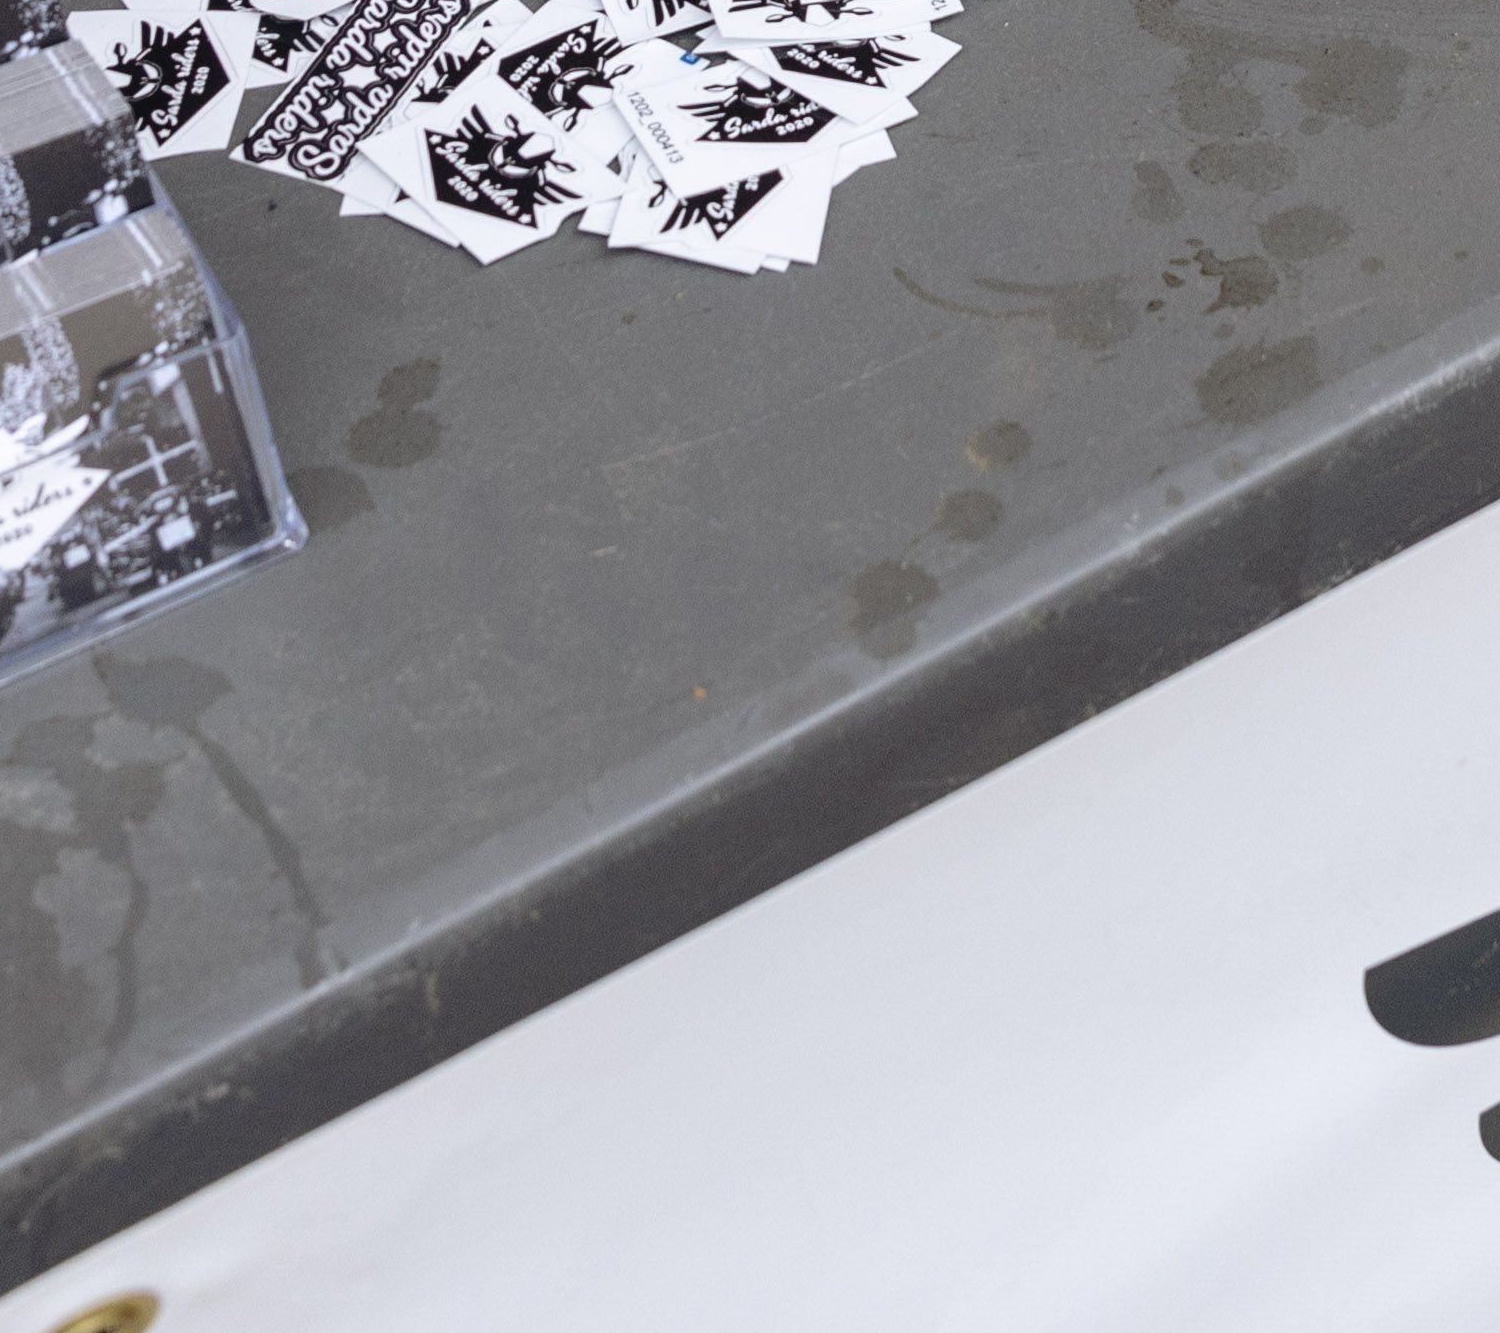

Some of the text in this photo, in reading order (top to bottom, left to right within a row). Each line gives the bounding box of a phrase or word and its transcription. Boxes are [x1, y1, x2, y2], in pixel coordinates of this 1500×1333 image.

[626, 90, 684, 163] 1202_000413
[439, 139, 520, 218] Sarda riders
